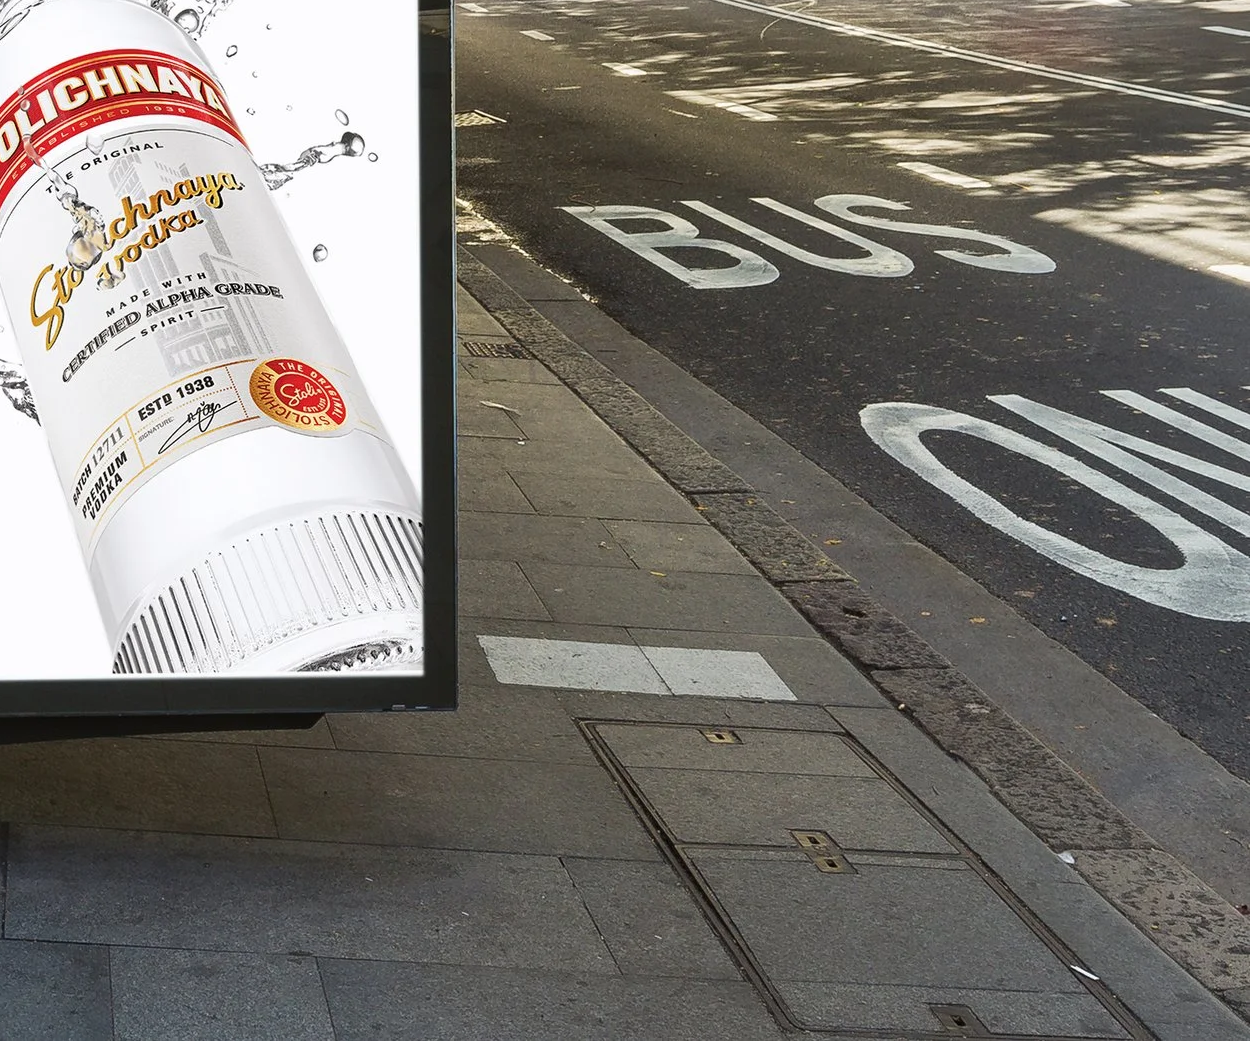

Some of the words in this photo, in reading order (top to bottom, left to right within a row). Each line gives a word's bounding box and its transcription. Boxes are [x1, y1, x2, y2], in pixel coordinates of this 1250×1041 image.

[11, 108, 130, 181] ESABLISHED
[145, 106, 186, 114] 1938
[80, 141, 165, 171] ORIGINAL
[555, 194, 1057, 290] BUS
[105, 289, 151, 318] MADE
[161, 272, 208, 289] WITH
[62, 311, 142, 383] CERTIFIED
[146, 286, 214, 318] ALPHA
[214, 283, 284, 300] GRADE
[140, 311, 195, 337] SPIRIT
[176, 375, 215, 399] 1938
[257, 371, 331, 426] STOLICHNAYA
[278, 362, 304, 373] THE
[310, 371, 344, 419] ORIGINAL
[72, 463, 92, 506] BATCH
[92, 426, 124, 469] 12711
[82, 451, 128, 519] PREMIUM
[89, 472, 123, 521] VODKA
